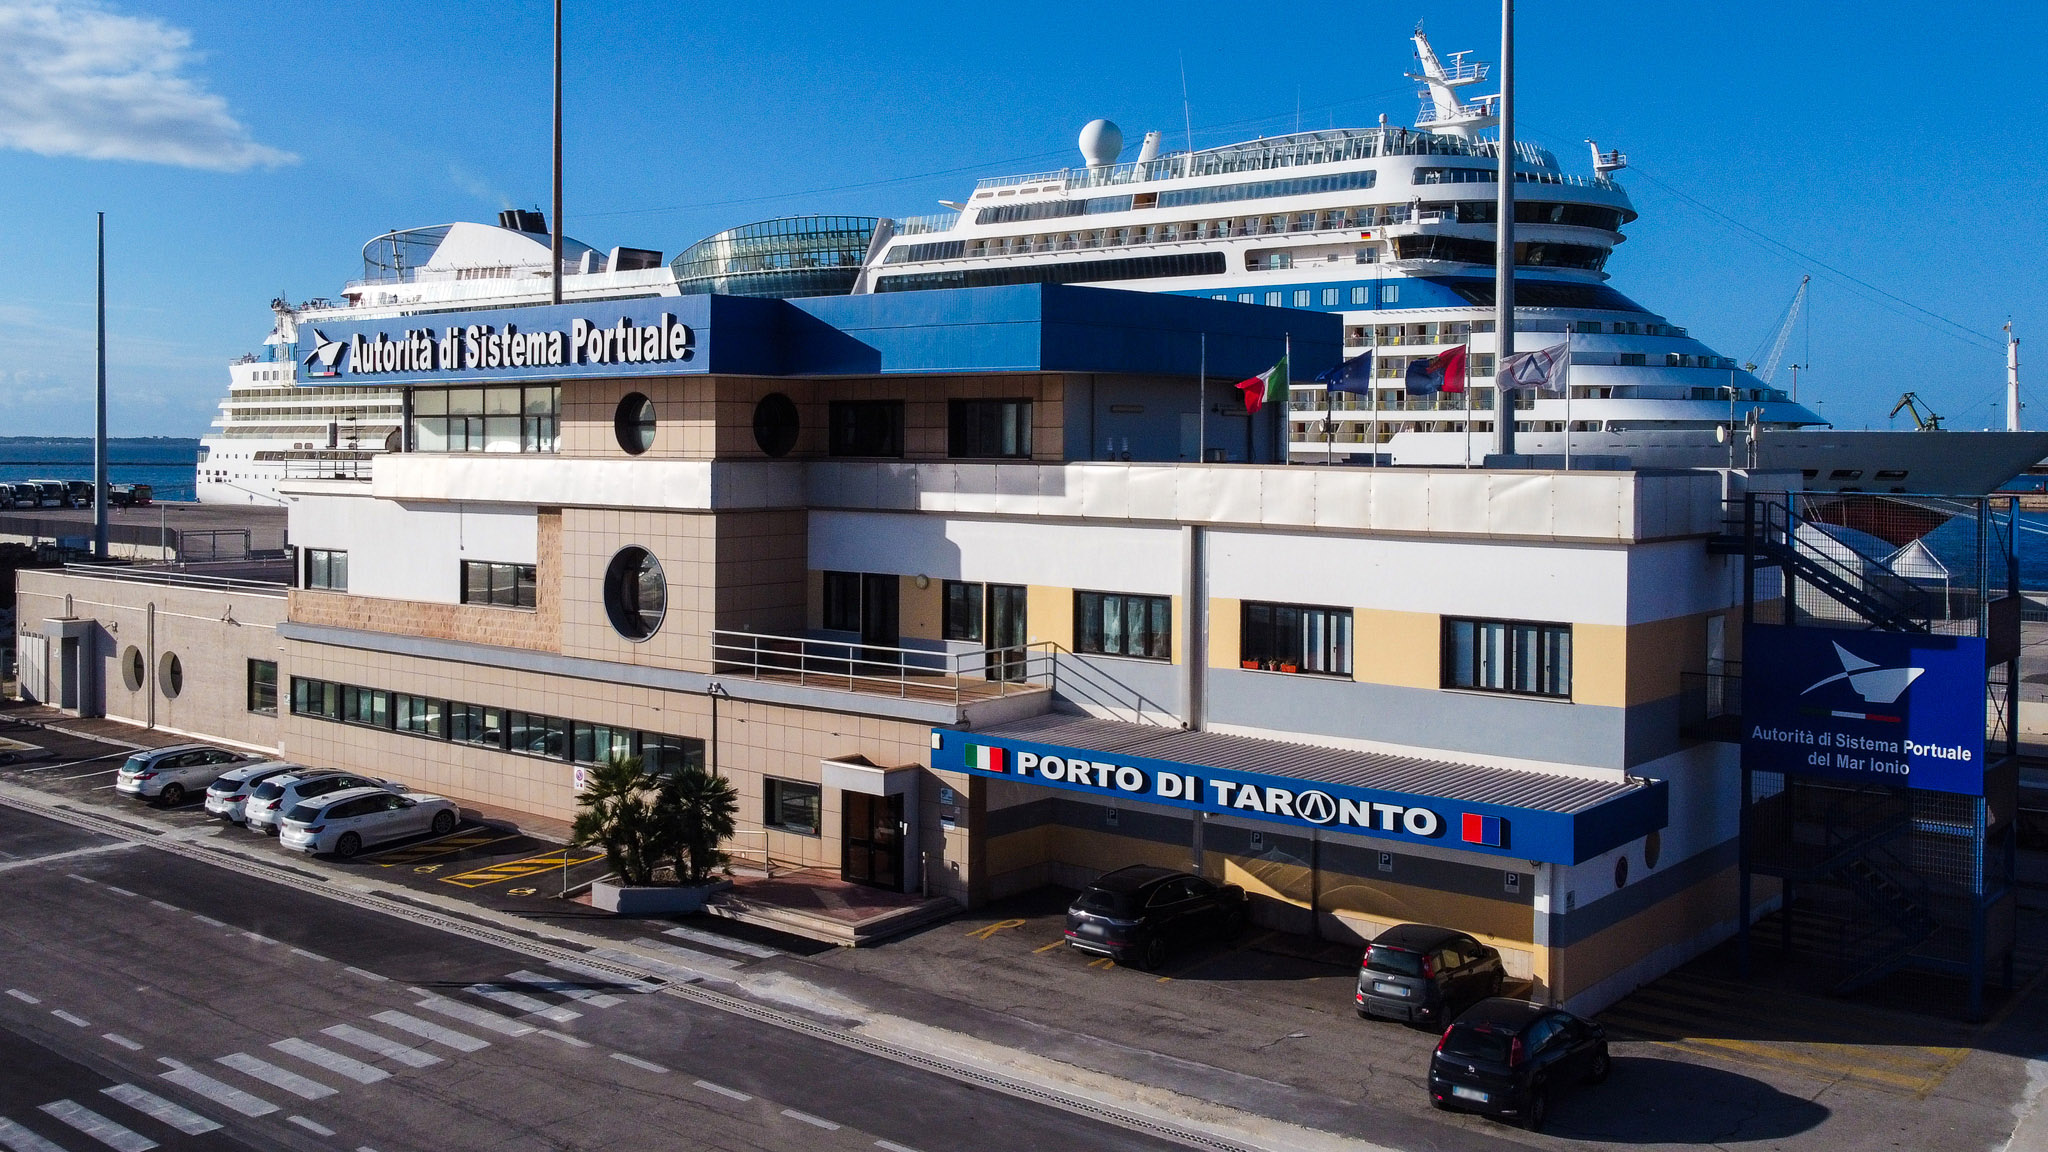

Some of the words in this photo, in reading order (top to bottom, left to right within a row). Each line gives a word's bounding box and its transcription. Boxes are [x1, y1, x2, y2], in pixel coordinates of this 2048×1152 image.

[347, 328, 433, 373] Autorità
[438, 326, 460, 370] di
[465, 322, 562, 369] Sistema
[571, 312, 686, 364] Portuale
[1752, 725, 1814, 745] Autorità
[1818, 732, 1831, 746] di
[1835, 733, 1899, 754] Sistema
[1903, 739, 1972, 762] Portuale
[1807, 751, 1831, 767] del
[1836, 753, 1867, 770] Mar
[1870, 757, 1910, 775] Ionio
[1017, 751, 1144, 792] PORTO
[1156, 771, 1195, 801] DI
